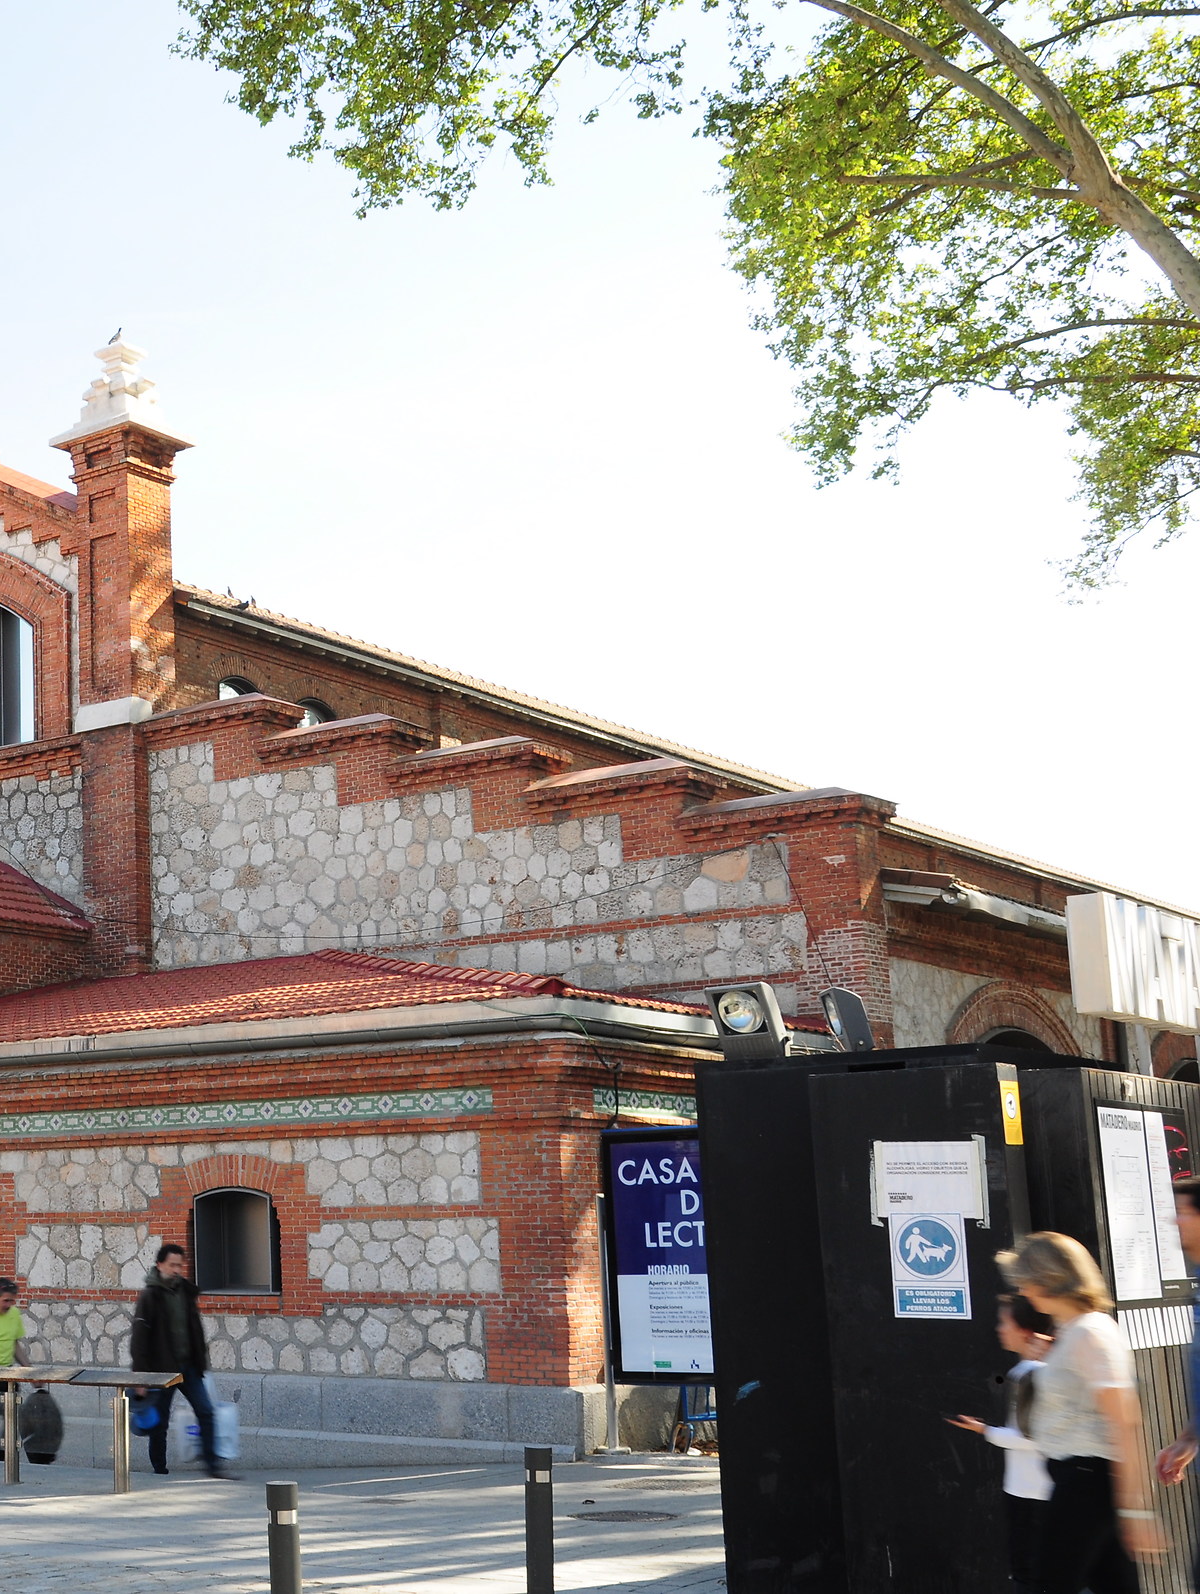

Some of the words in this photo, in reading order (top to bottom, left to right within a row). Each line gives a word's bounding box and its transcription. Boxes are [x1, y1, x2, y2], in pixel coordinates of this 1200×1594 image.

[1100, 1112, 1128, 1130] MATADERO
[617, 1156, 698, 1186] CASA
[647, 1264, 690, 1275] HORARIO
